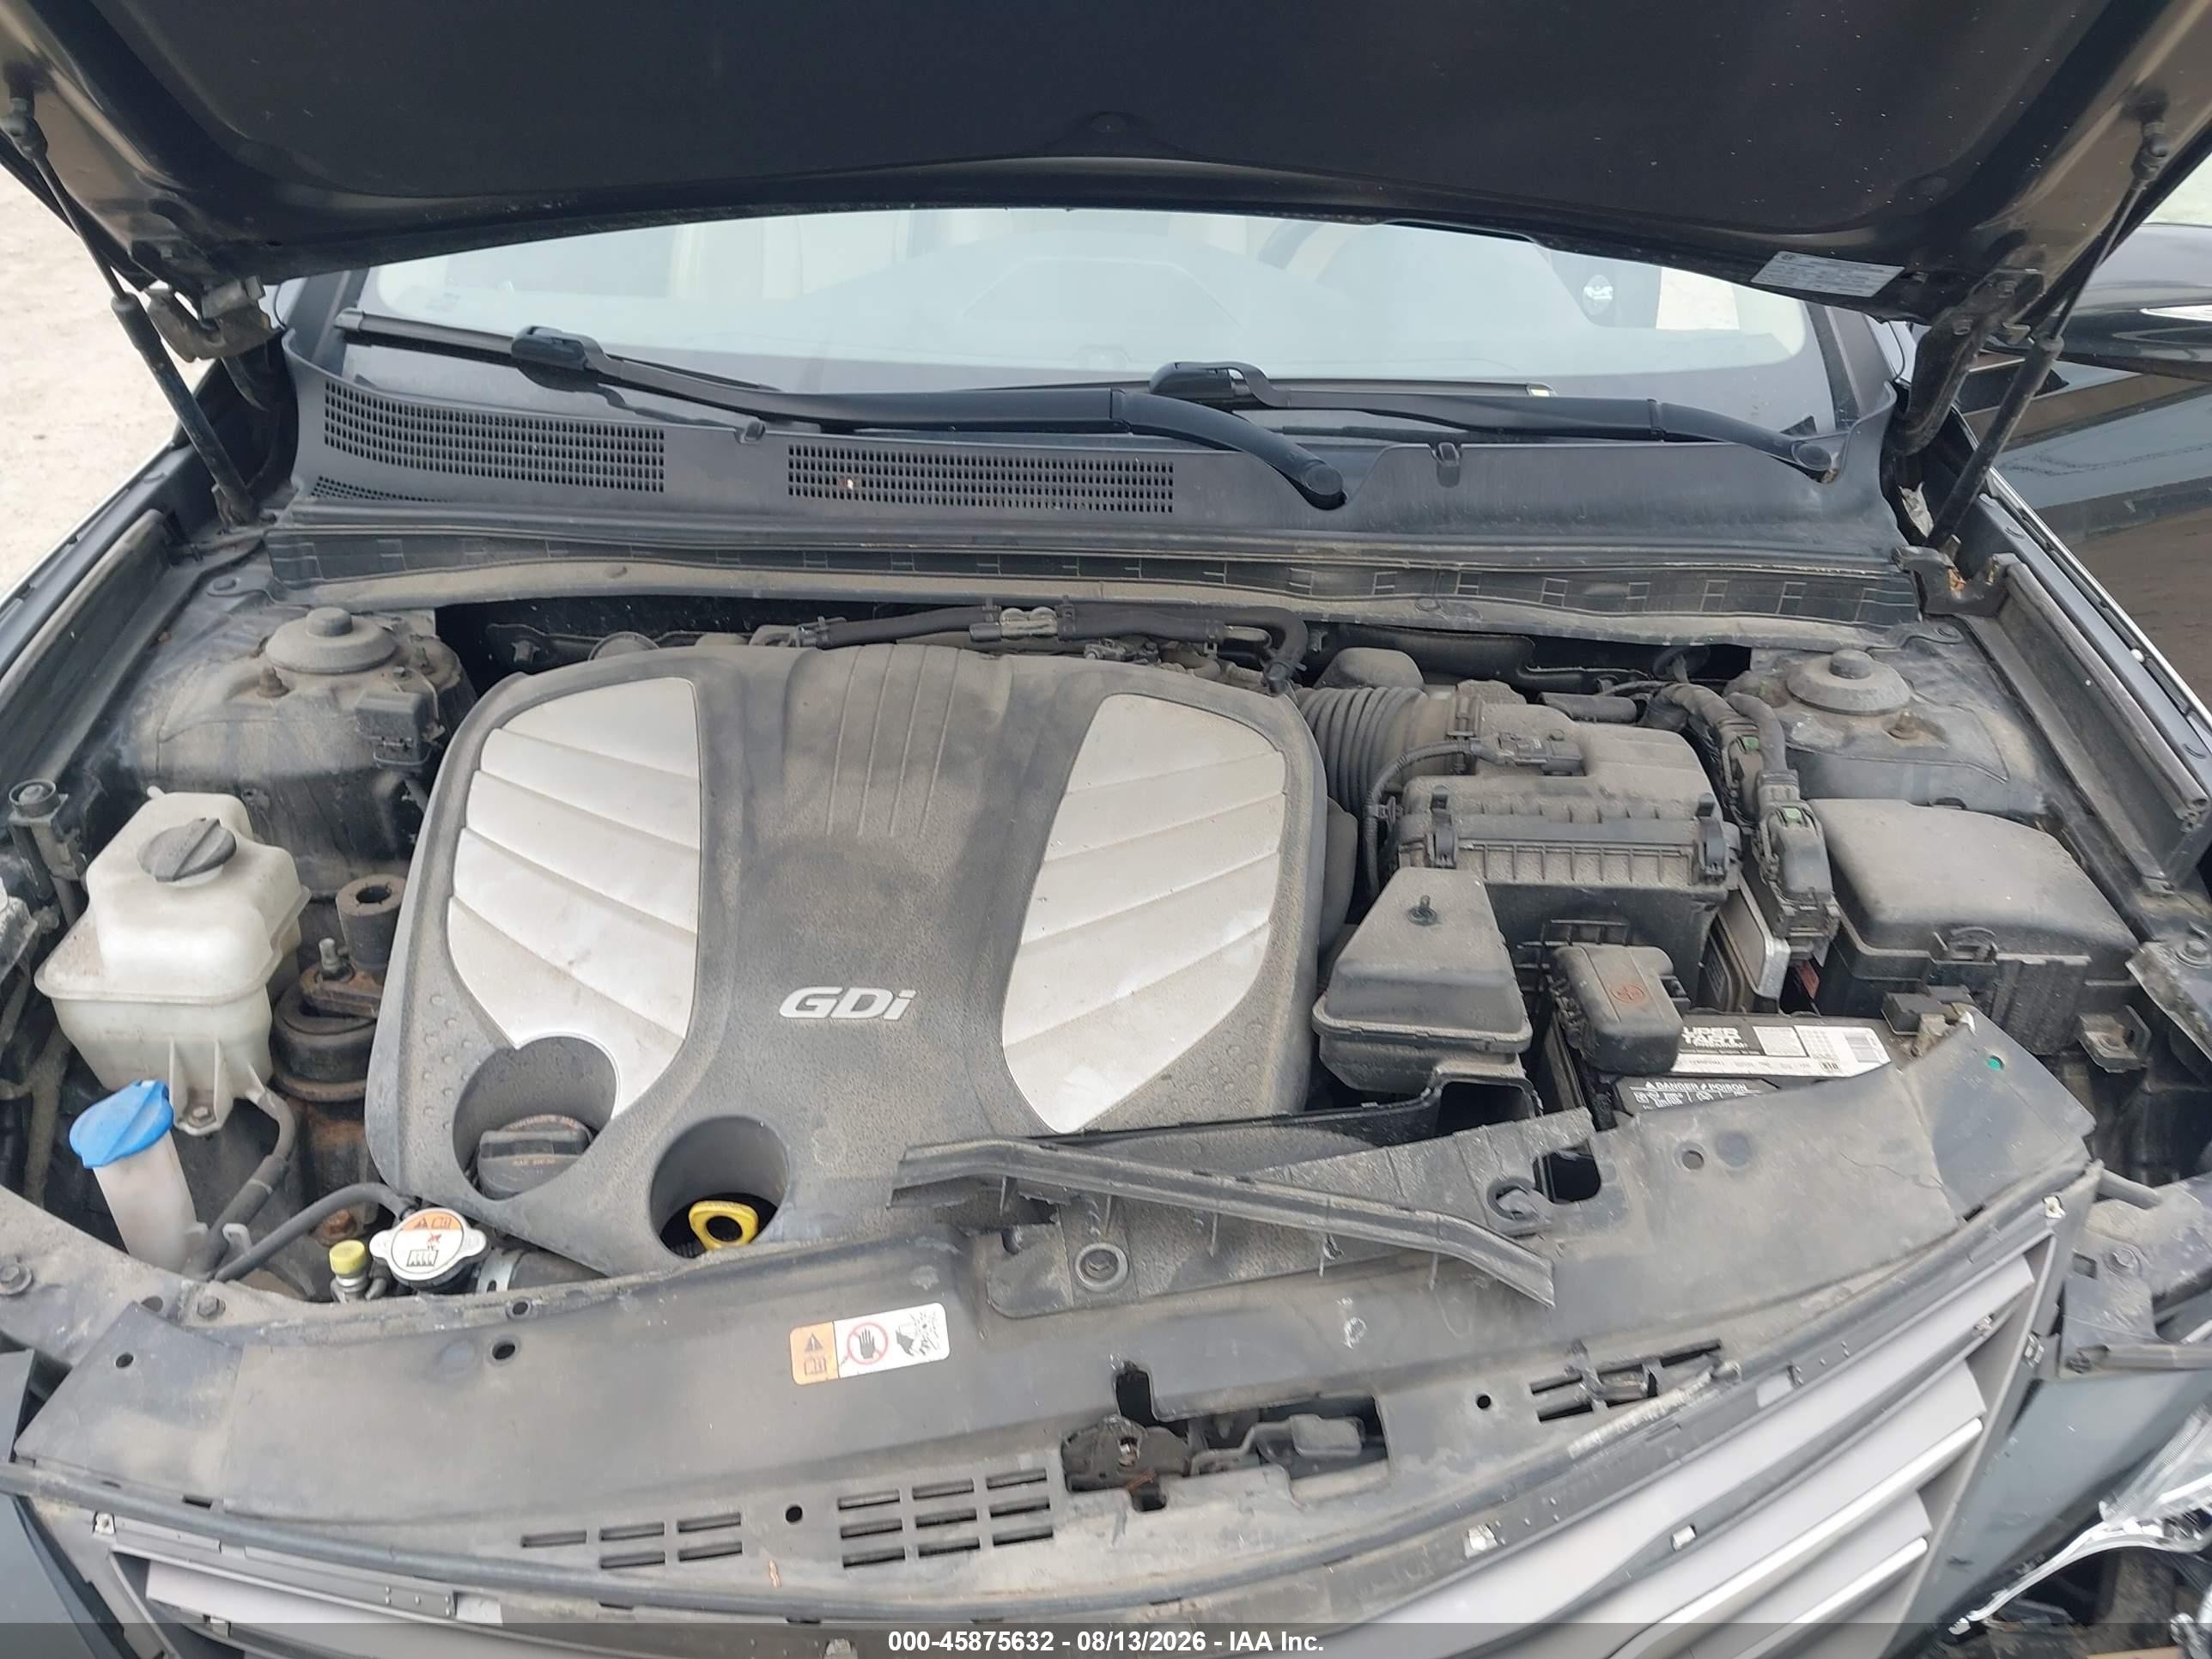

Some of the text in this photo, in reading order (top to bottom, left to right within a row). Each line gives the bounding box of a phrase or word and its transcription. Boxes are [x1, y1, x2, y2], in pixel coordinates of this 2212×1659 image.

[779, 986, 916, 1020] GDi
[1681, 1033, 1738, 1045] TART
[1682, 1026, 1741, 1039] UPER
